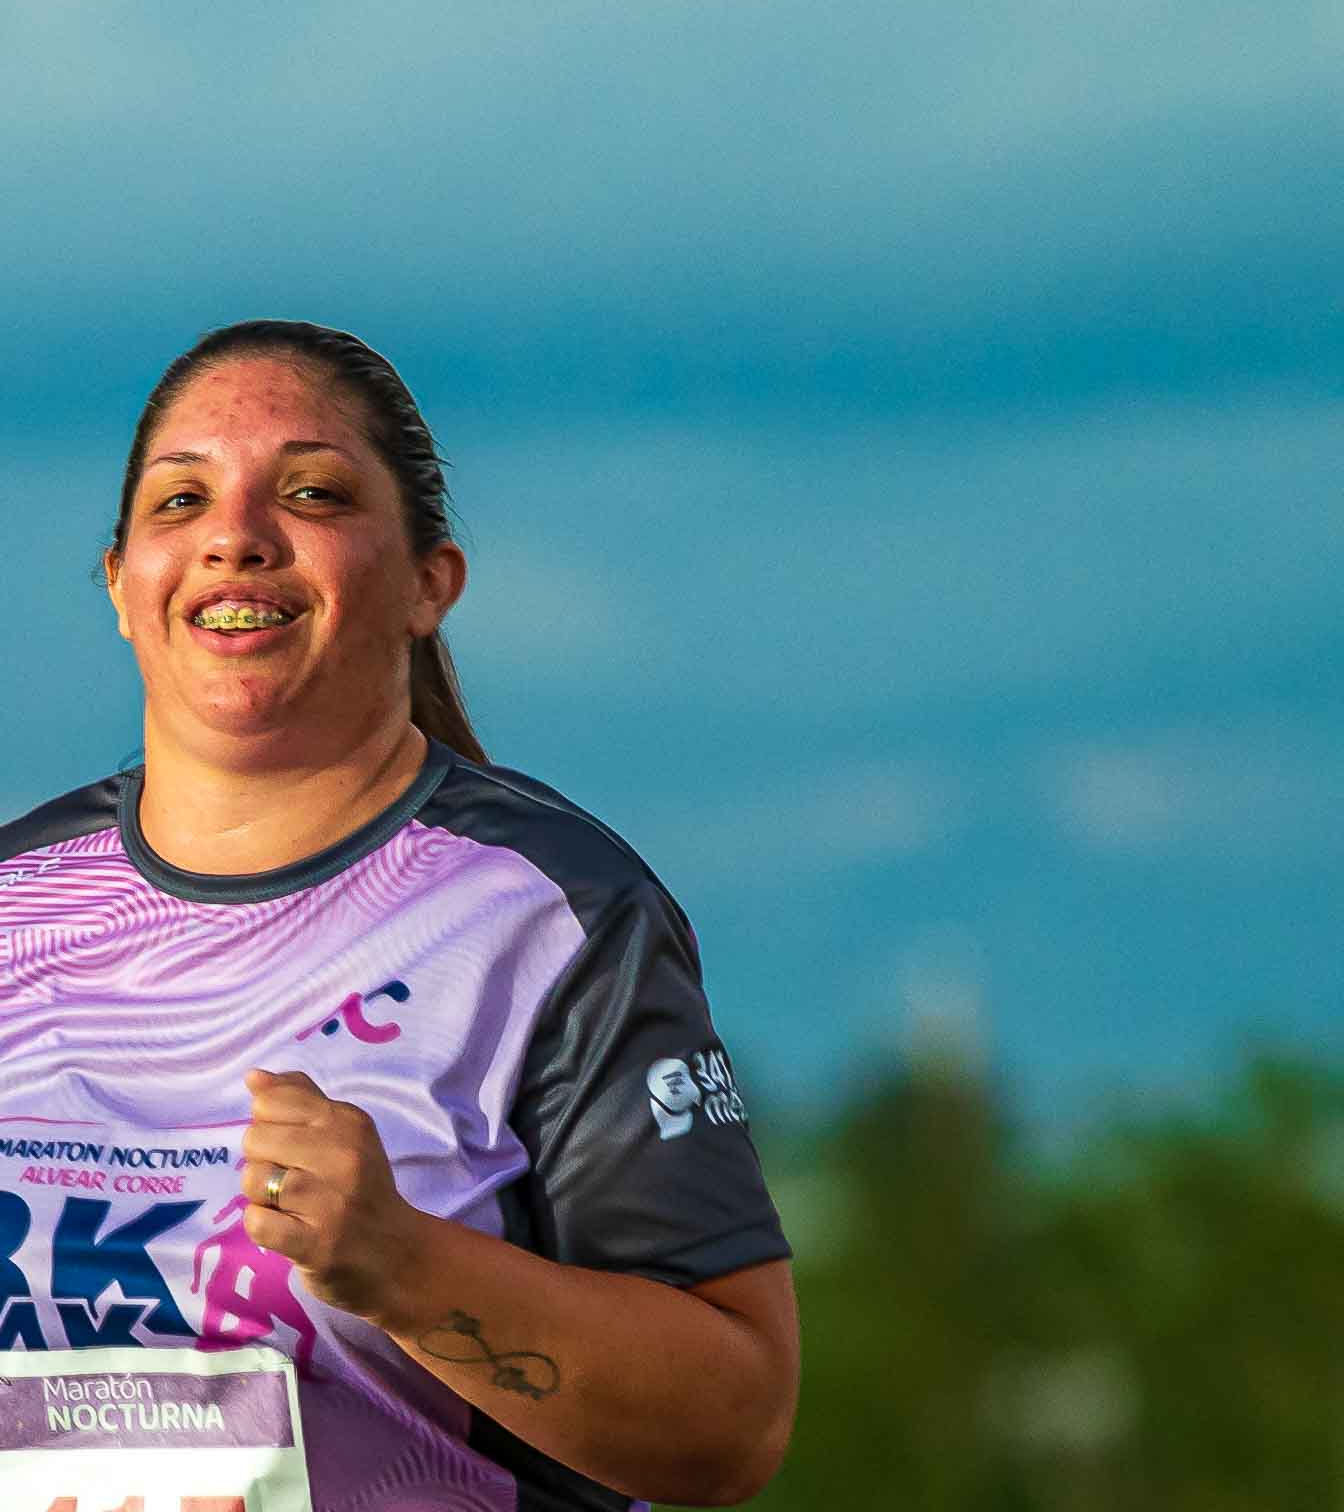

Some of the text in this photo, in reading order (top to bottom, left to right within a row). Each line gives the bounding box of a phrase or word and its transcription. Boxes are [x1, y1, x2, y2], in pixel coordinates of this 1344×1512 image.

[109, 1144, 229, 1169] NOCTURNA
[19, 1166, 187, 1194] ALVEAR CORRE
[43, 1372, 155, 1403] Maratón
[46, 1403, 226, 1434] NOCTURNA
